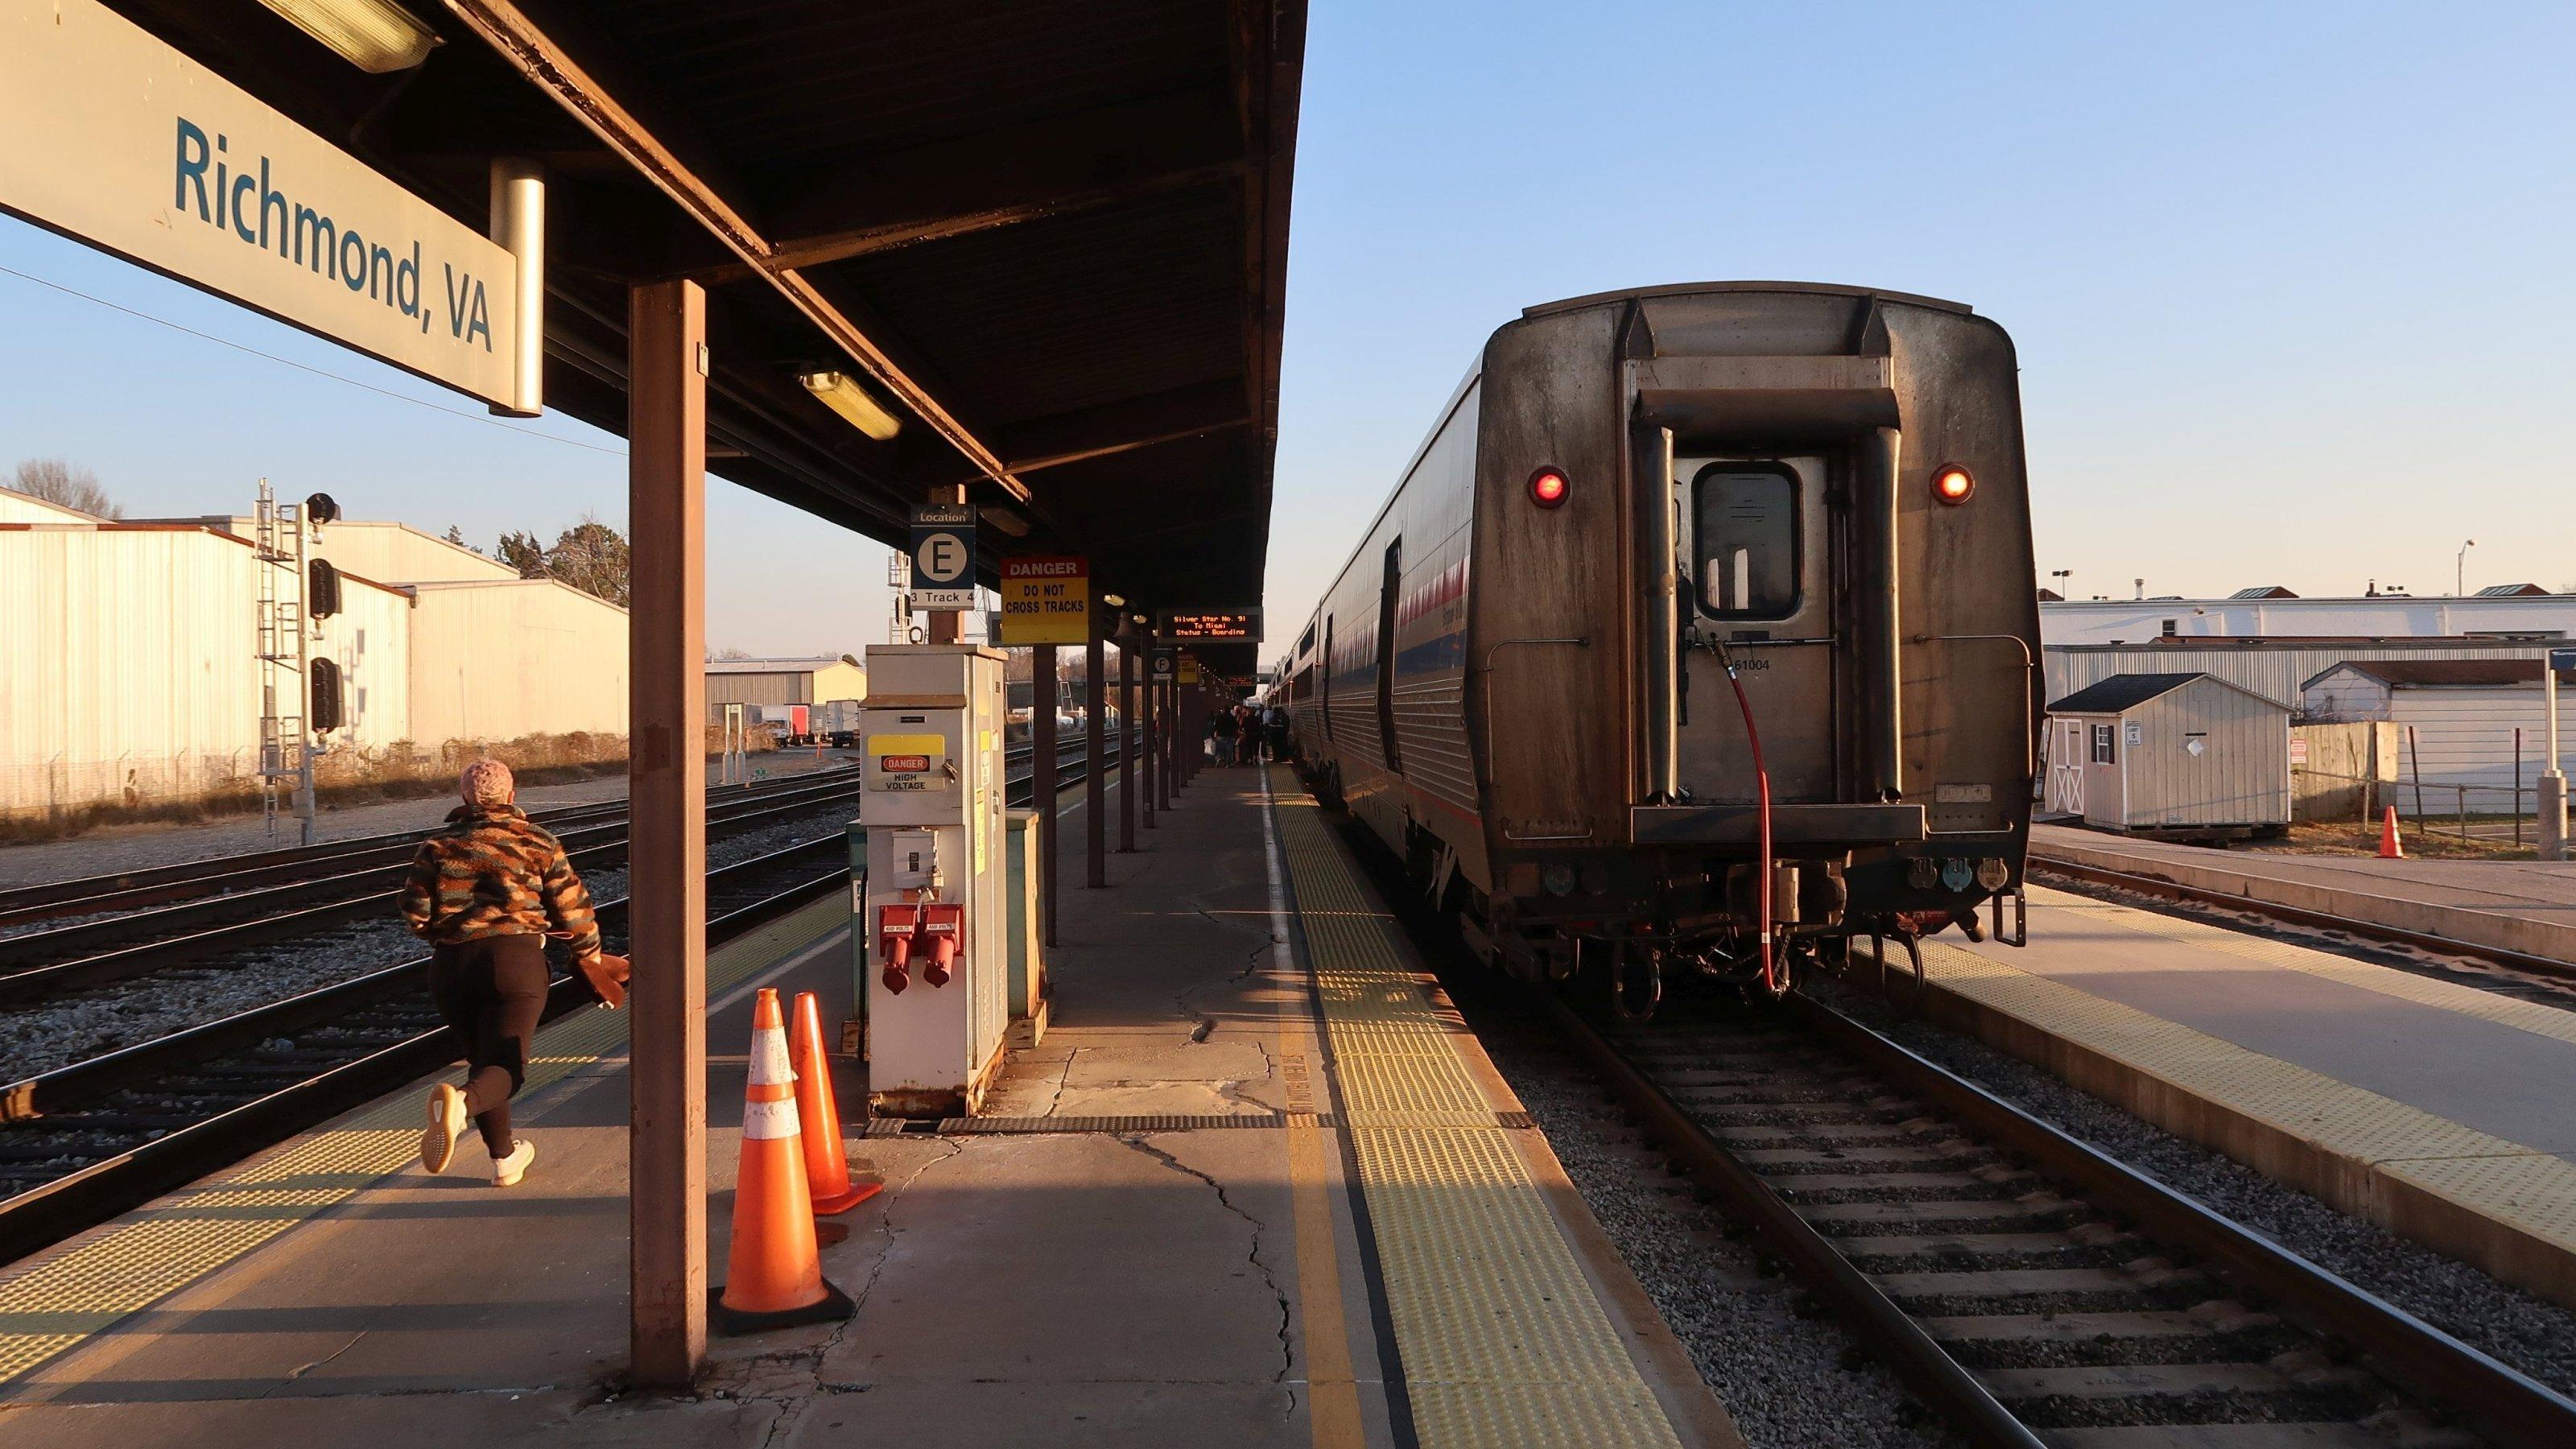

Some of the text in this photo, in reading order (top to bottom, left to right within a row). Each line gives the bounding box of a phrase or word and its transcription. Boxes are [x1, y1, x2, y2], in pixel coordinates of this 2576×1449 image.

[175, 115, 493, 353] Richmond, VA
[920, 513, 966, 522] Location
[933, 541, 952, 574] E
[1009, 563, 1077, 576] DANGER
[1024, 584, 1065, 597] DO NOT
[910, 592, 974, 602] 3 Track 4
[1005, 601, 1084, 613] CROSS TRACKS
[1159, 658, 1166, 670] F
[1735, 659, 1770, 671] 61004
[888, 759, 923, 768] DANGER
[894, 774, 917, 782] HIGH
